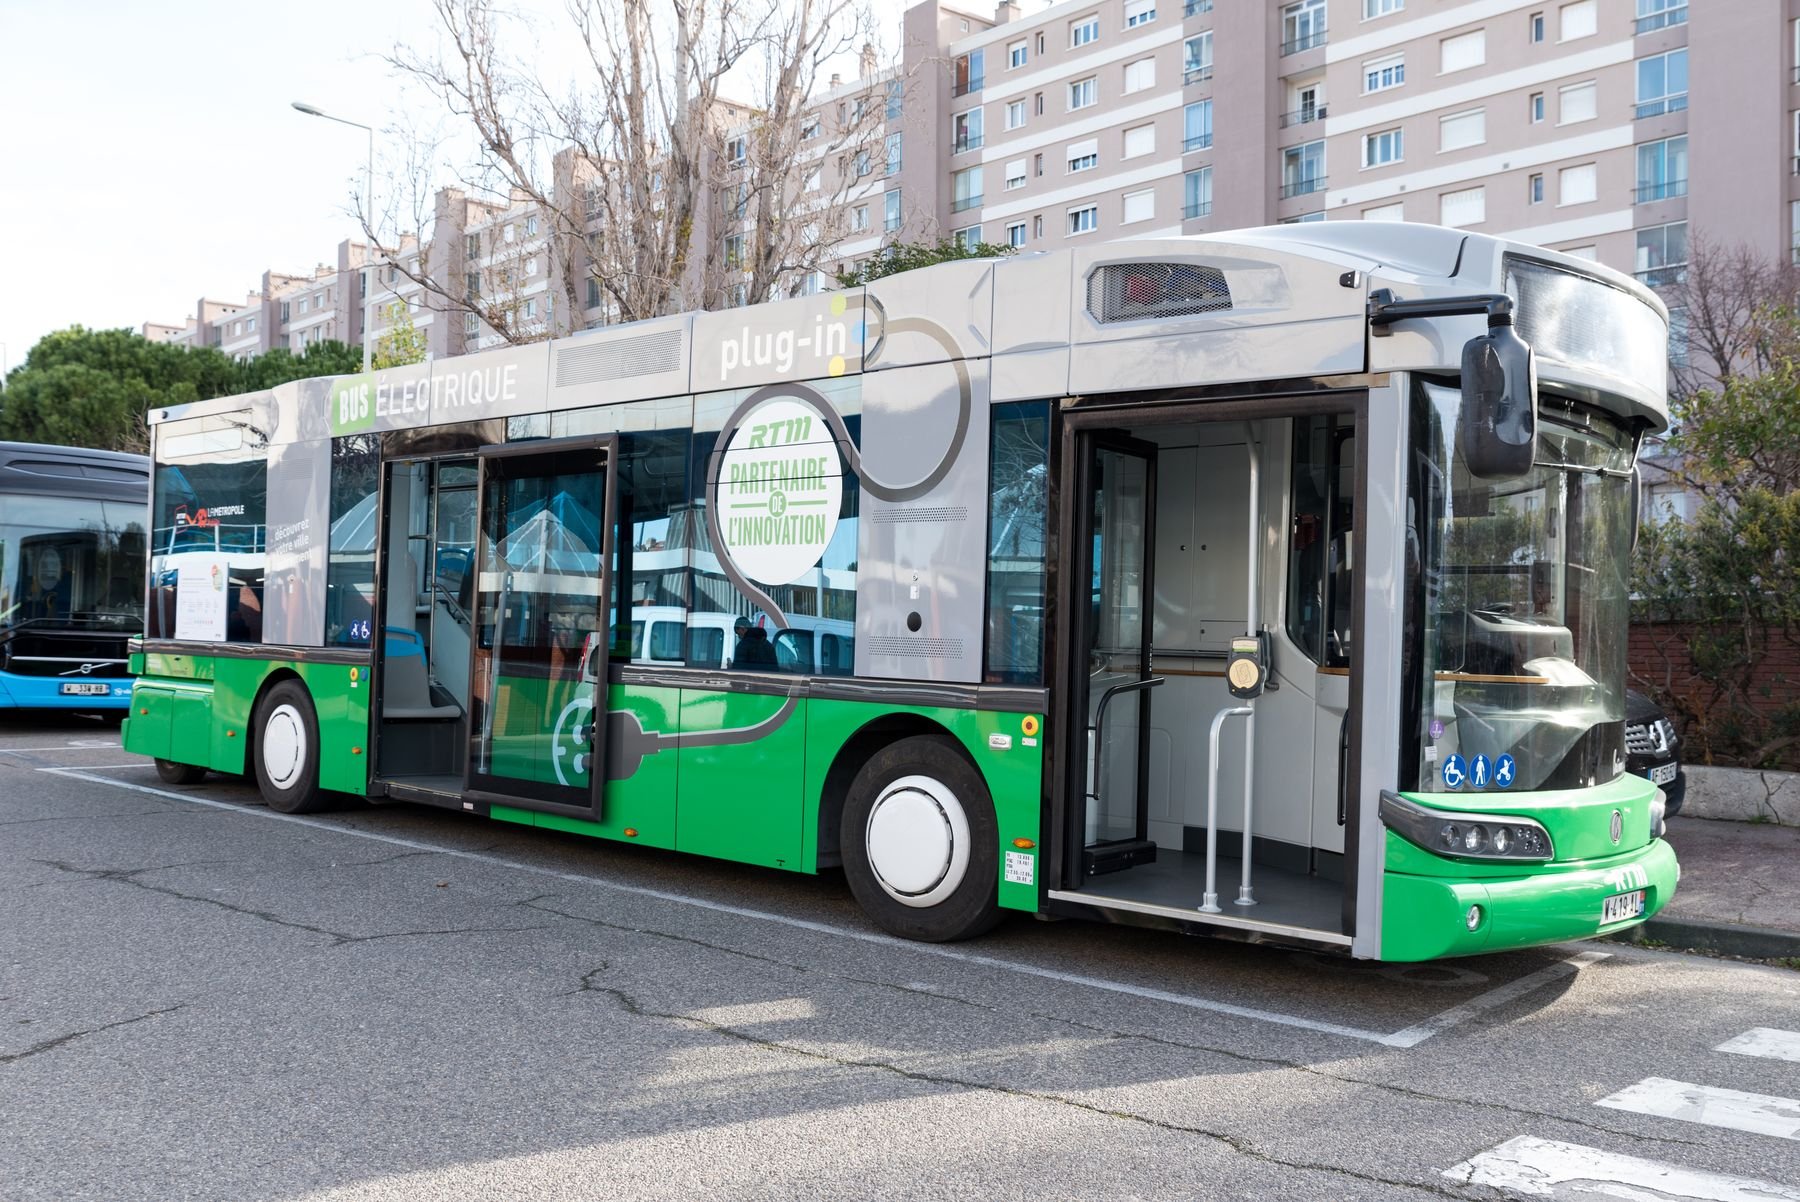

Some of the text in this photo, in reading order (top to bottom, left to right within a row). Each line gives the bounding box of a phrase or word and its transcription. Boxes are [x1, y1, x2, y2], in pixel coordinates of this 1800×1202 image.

[721, 314, 847, 381] plug-in
[339, 364, 518, 425] BUS ÉLECTRIQUE
[749, 416, 812, 450] RTM
[730, 457, 828, 495] PARTENAIRE
[772, 495, 783, 513] DE
[728, 514, 826, 547] L'INNOVATION
